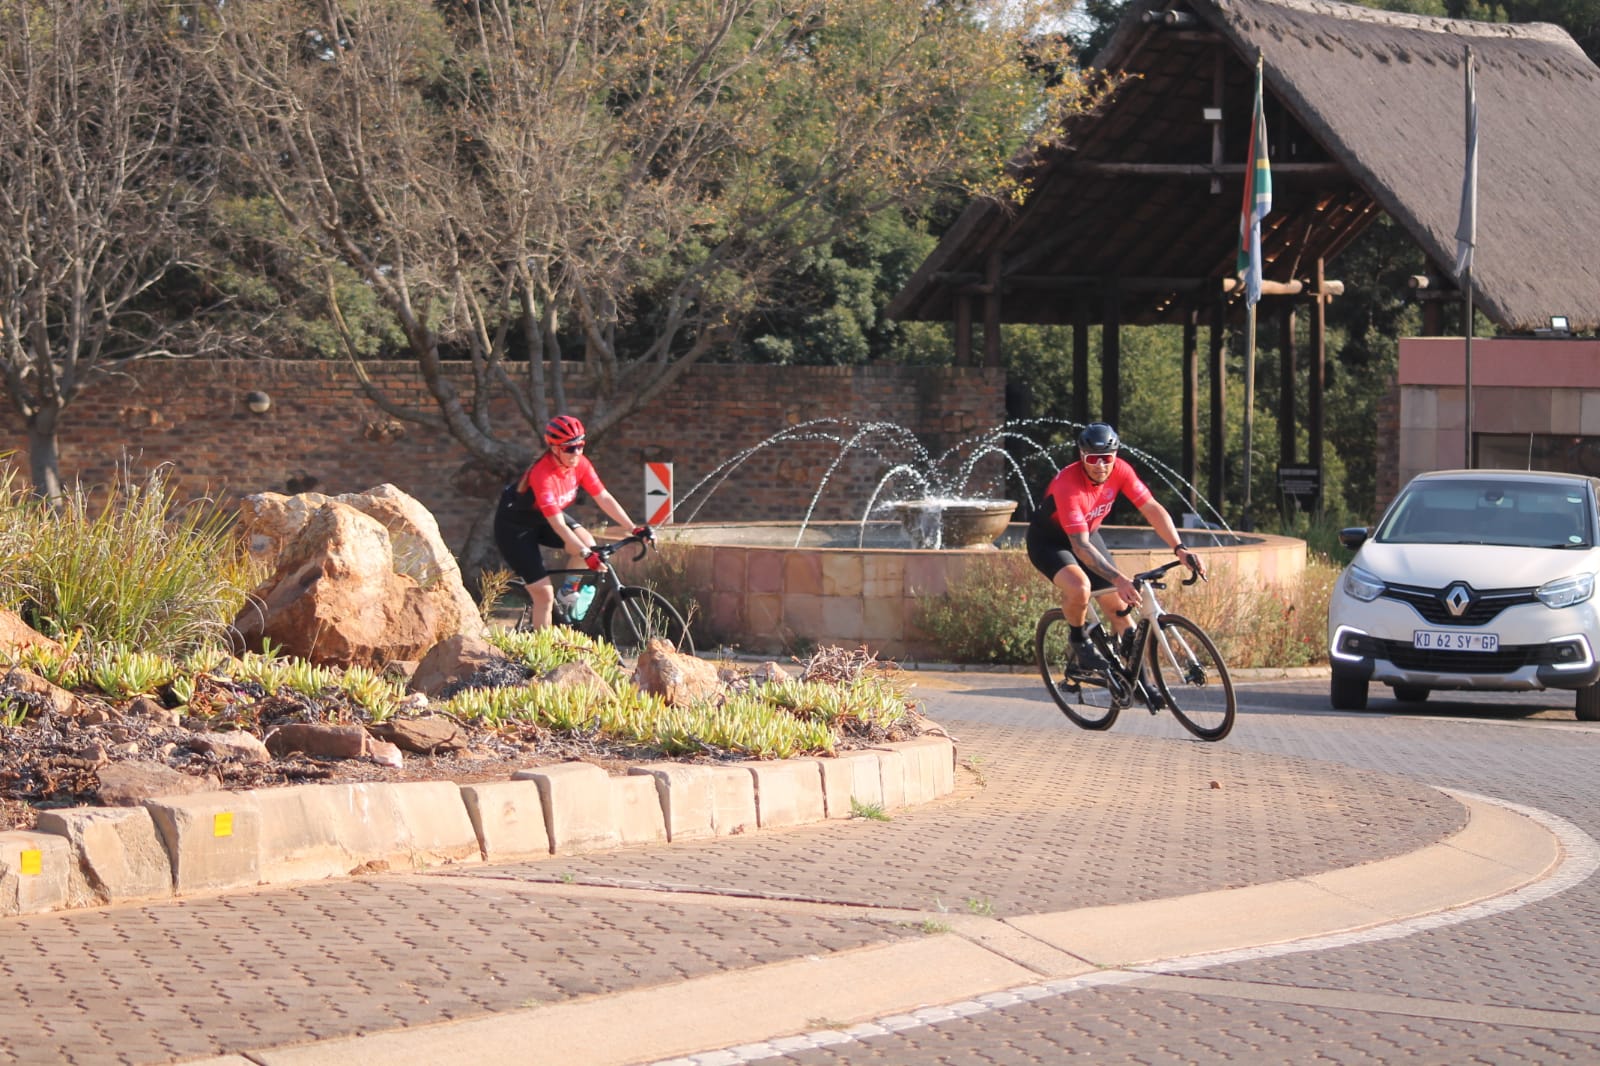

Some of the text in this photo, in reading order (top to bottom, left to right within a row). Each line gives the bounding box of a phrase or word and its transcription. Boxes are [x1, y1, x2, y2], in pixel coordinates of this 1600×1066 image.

[1416, 633, 1496, 649] KD 62 SY GP
